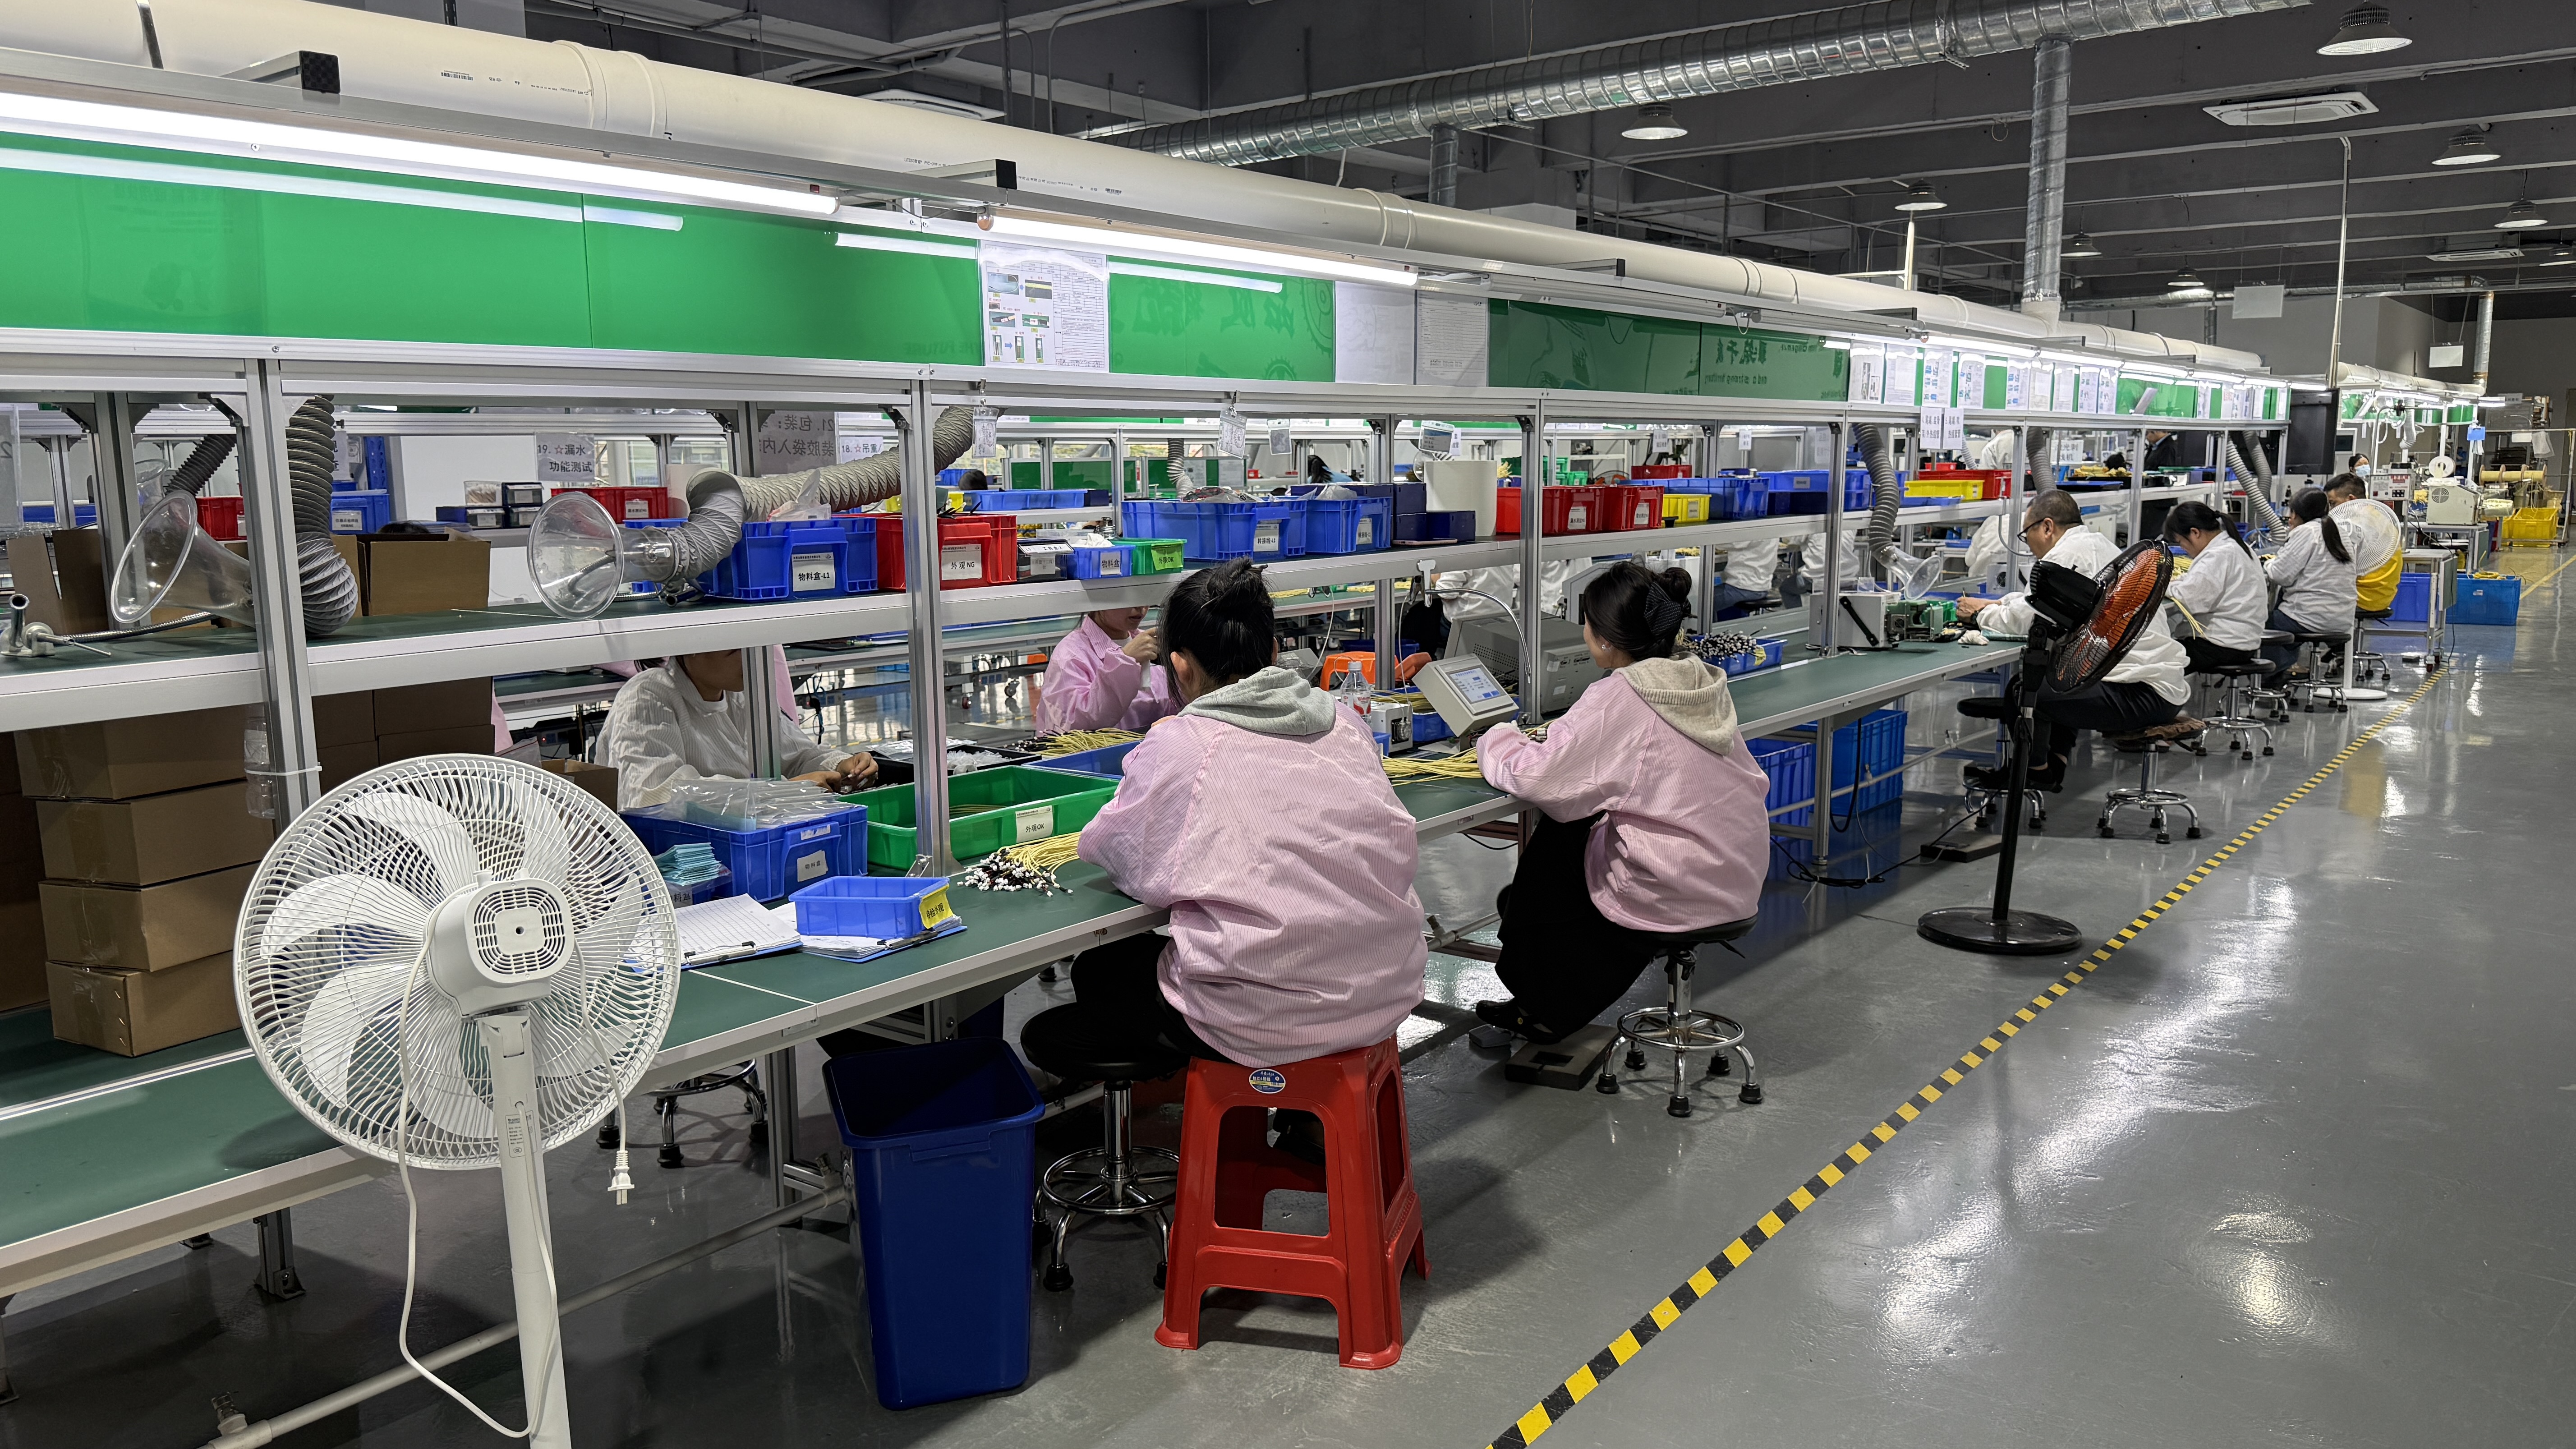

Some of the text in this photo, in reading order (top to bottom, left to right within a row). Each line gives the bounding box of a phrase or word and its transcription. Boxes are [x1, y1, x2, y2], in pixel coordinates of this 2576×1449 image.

[549, 461, 593, 473] 功能测试
[1101, 558, 1120, 568] 物料盒
[798, 572, 830, 581] 物料盒-L1
